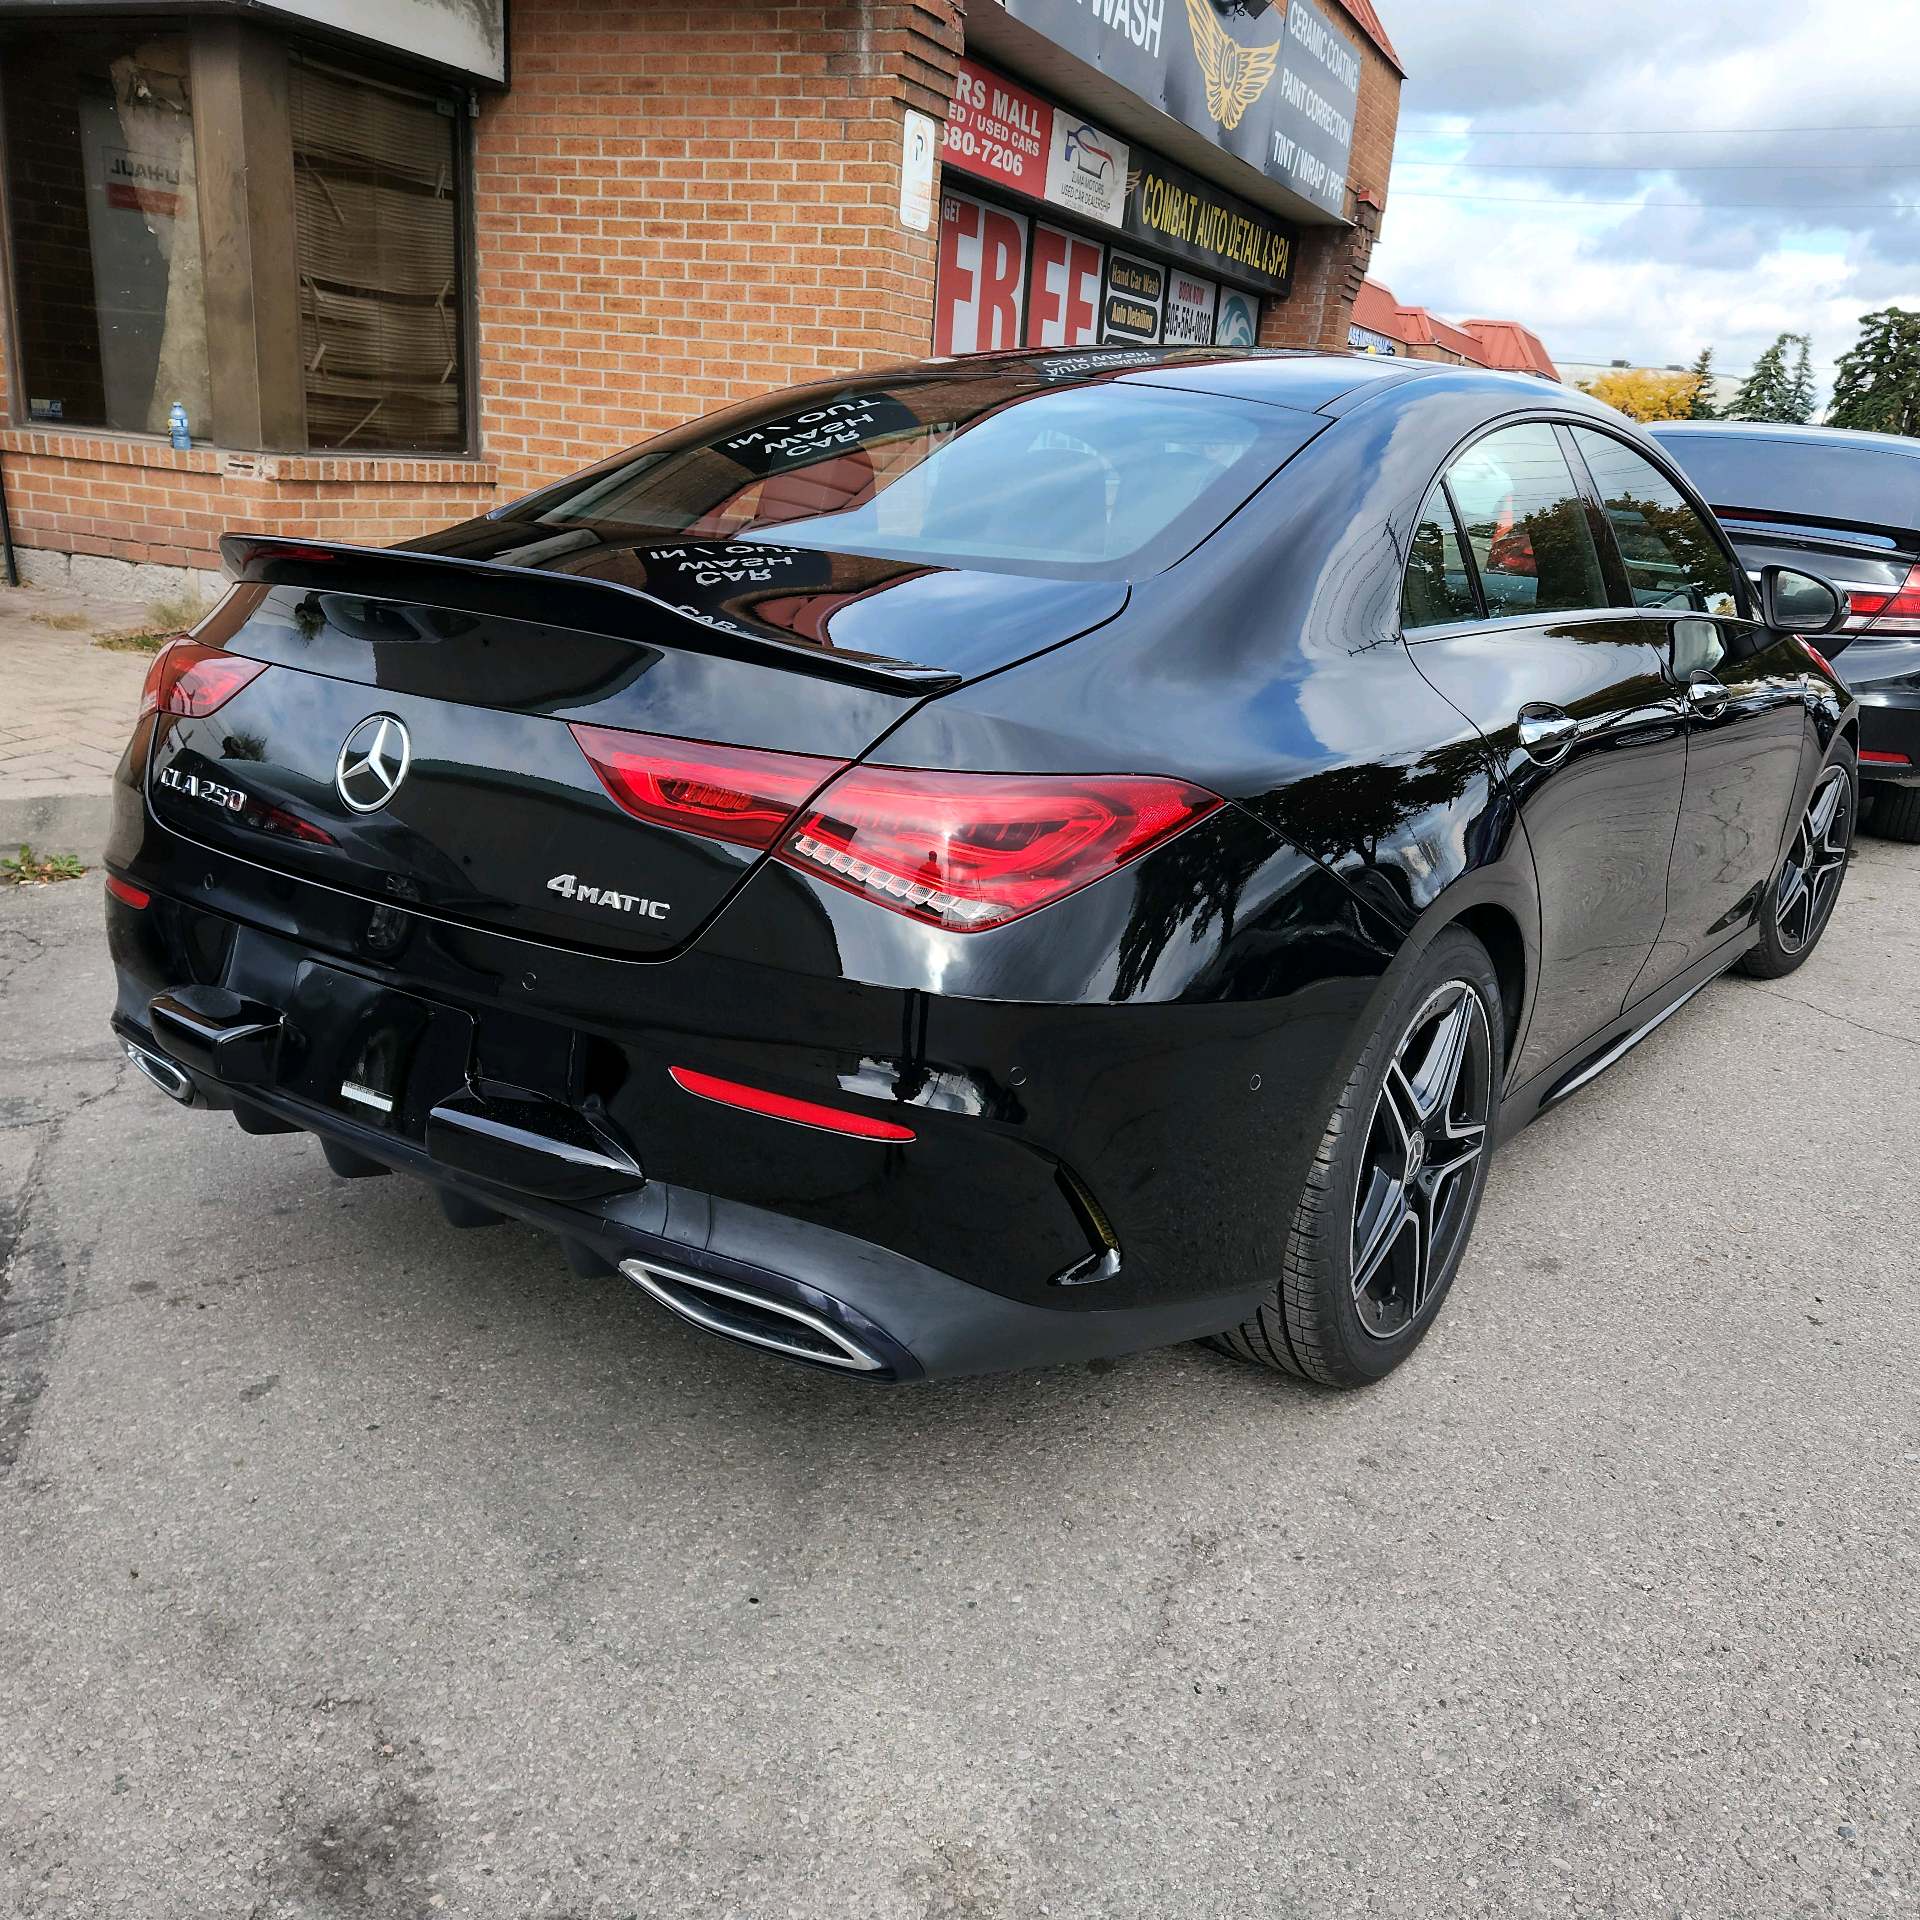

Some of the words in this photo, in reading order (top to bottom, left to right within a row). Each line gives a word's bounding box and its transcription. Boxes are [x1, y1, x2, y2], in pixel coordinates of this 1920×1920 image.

[1290, 1, 1327, 62] CERAMIC
[1327, 38, 1358, 93] COATING
[992, 89, 1041, 139] MALL
[1281, 67, 1307, 111] PAINT
[1305, 89, 1351, 149] CORRECTION
[977, 115, 1009, 142] USED
[1011, 131, 1040, 157] CARS
[1273, 130, 1295, 171] TINT
[1300, 150, 1325, 189] WRAP
[1329, 171, 1345, 203] PPF
[943, 198, 961, 223] GET
[1061, 183, 1074, 198] USED
[1074, 189, 1085, 203] CAR
[1142, 174, 1198, 242] COMBAT
[1195, 201, 1228, 254] AUTO
[1227, 214, 1263, 268] DETAIL
[1261, 231, 1271, 272] &
[1268, 235, 1290, 279] SPA
[933, 194, 1100, 357] FREE
[1112, 263, 1130, 287] Hand
[1130, 271, 1142, 290] Car
[1143, 274, 1160, 295] Wash
[1178, 280, 1192, 303] BOOK
[1111, 302, 1124, 323] Auto
[1127, 306, 1153, 332] Detailing
[200, 780, 247, 812] 250
[547, 873, 671, 920] 4MATIC
